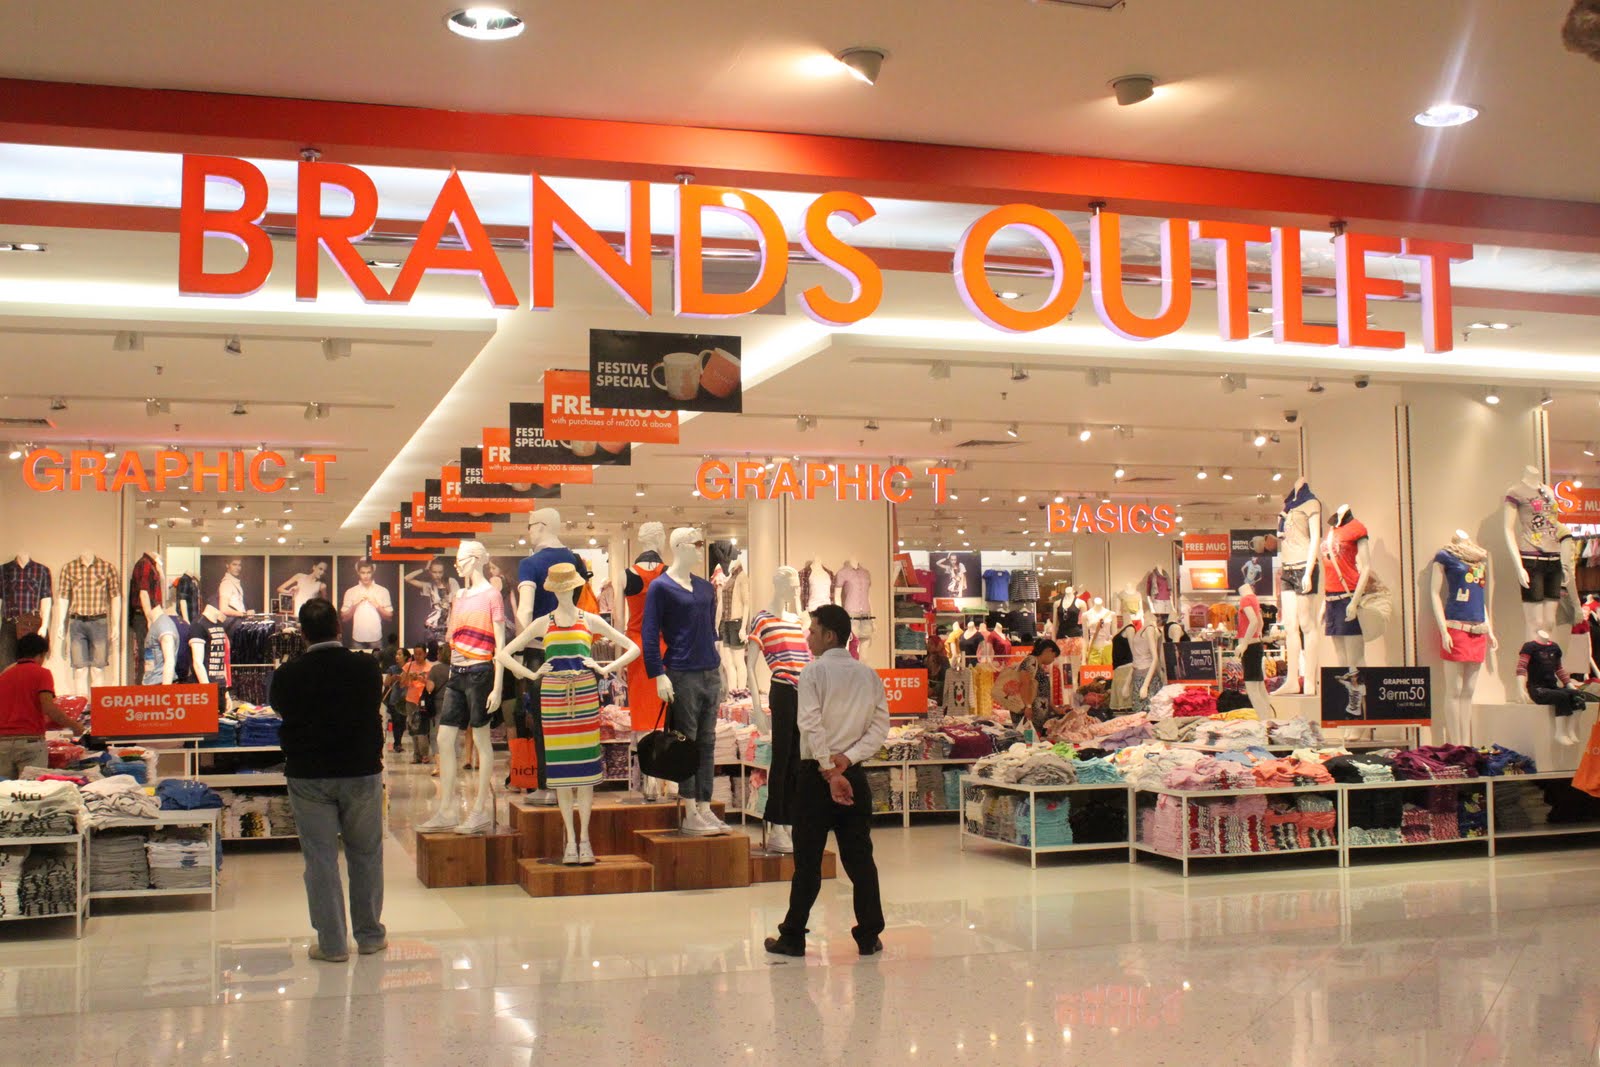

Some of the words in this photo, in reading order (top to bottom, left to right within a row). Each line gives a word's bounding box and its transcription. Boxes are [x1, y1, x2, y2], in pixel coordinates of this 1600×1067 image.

[178, 153, 883, 327] BRANDS
[953, 204, 1474, 353] OUTLET
[597, 362, 649, 375] FESTIVE
[596, 375, 651, 388] SPECIAL
[568, 418, 604, 427] purchases
[606, 418, 614, 426] of
[615, 419, 640, 427] rm200
[649, 420, 672, 428] above
[516, 427, 545, 437] FESTI
[515, 438, 559, 447] SPECIAL
[488, 446, 511, 463] FR
[22, 448, 286, 493] GRAPHIC
[302, 454, 337, 494] T
[696, 460, 913, 504] GRAPHIC
[926, 467, 956, 504] T
[1047, 503, 1176, 534] BASICS
[1185, 543, 1204, 551] FREE
[1206, 543, 1227, 551] MUG
[894, 677, 921, 688] TEES
[1378, 687, 1425, 700] 3@rm50
[101, 694, 171, 708] GRAPHIC
[175, 693, 209, 705] TEES
[125, 707, 186, 721] 3@rm50
